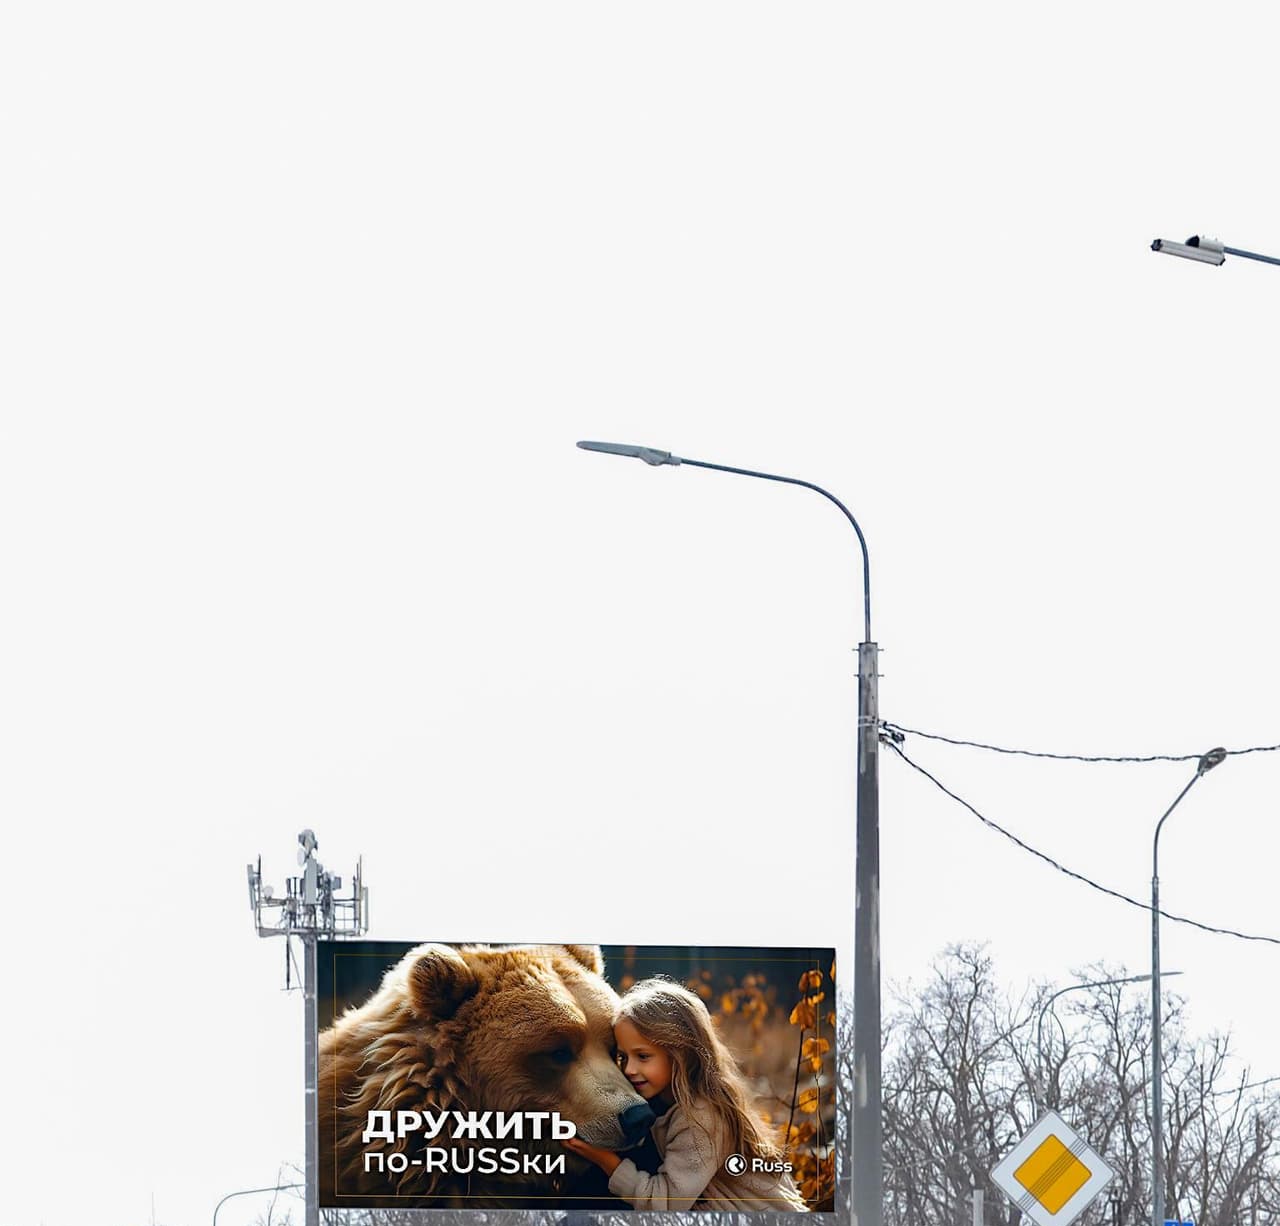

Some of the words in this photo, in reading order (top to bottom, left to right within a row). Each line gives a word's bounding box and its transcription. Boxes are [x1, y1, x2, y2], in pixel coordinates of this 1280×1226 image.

[362, 1110, 577, 1144] ДРУЖИТЬ
[364, 1147, 566, 1175] по-RUSSки
[751, 1158, 793, 1173] Russ
